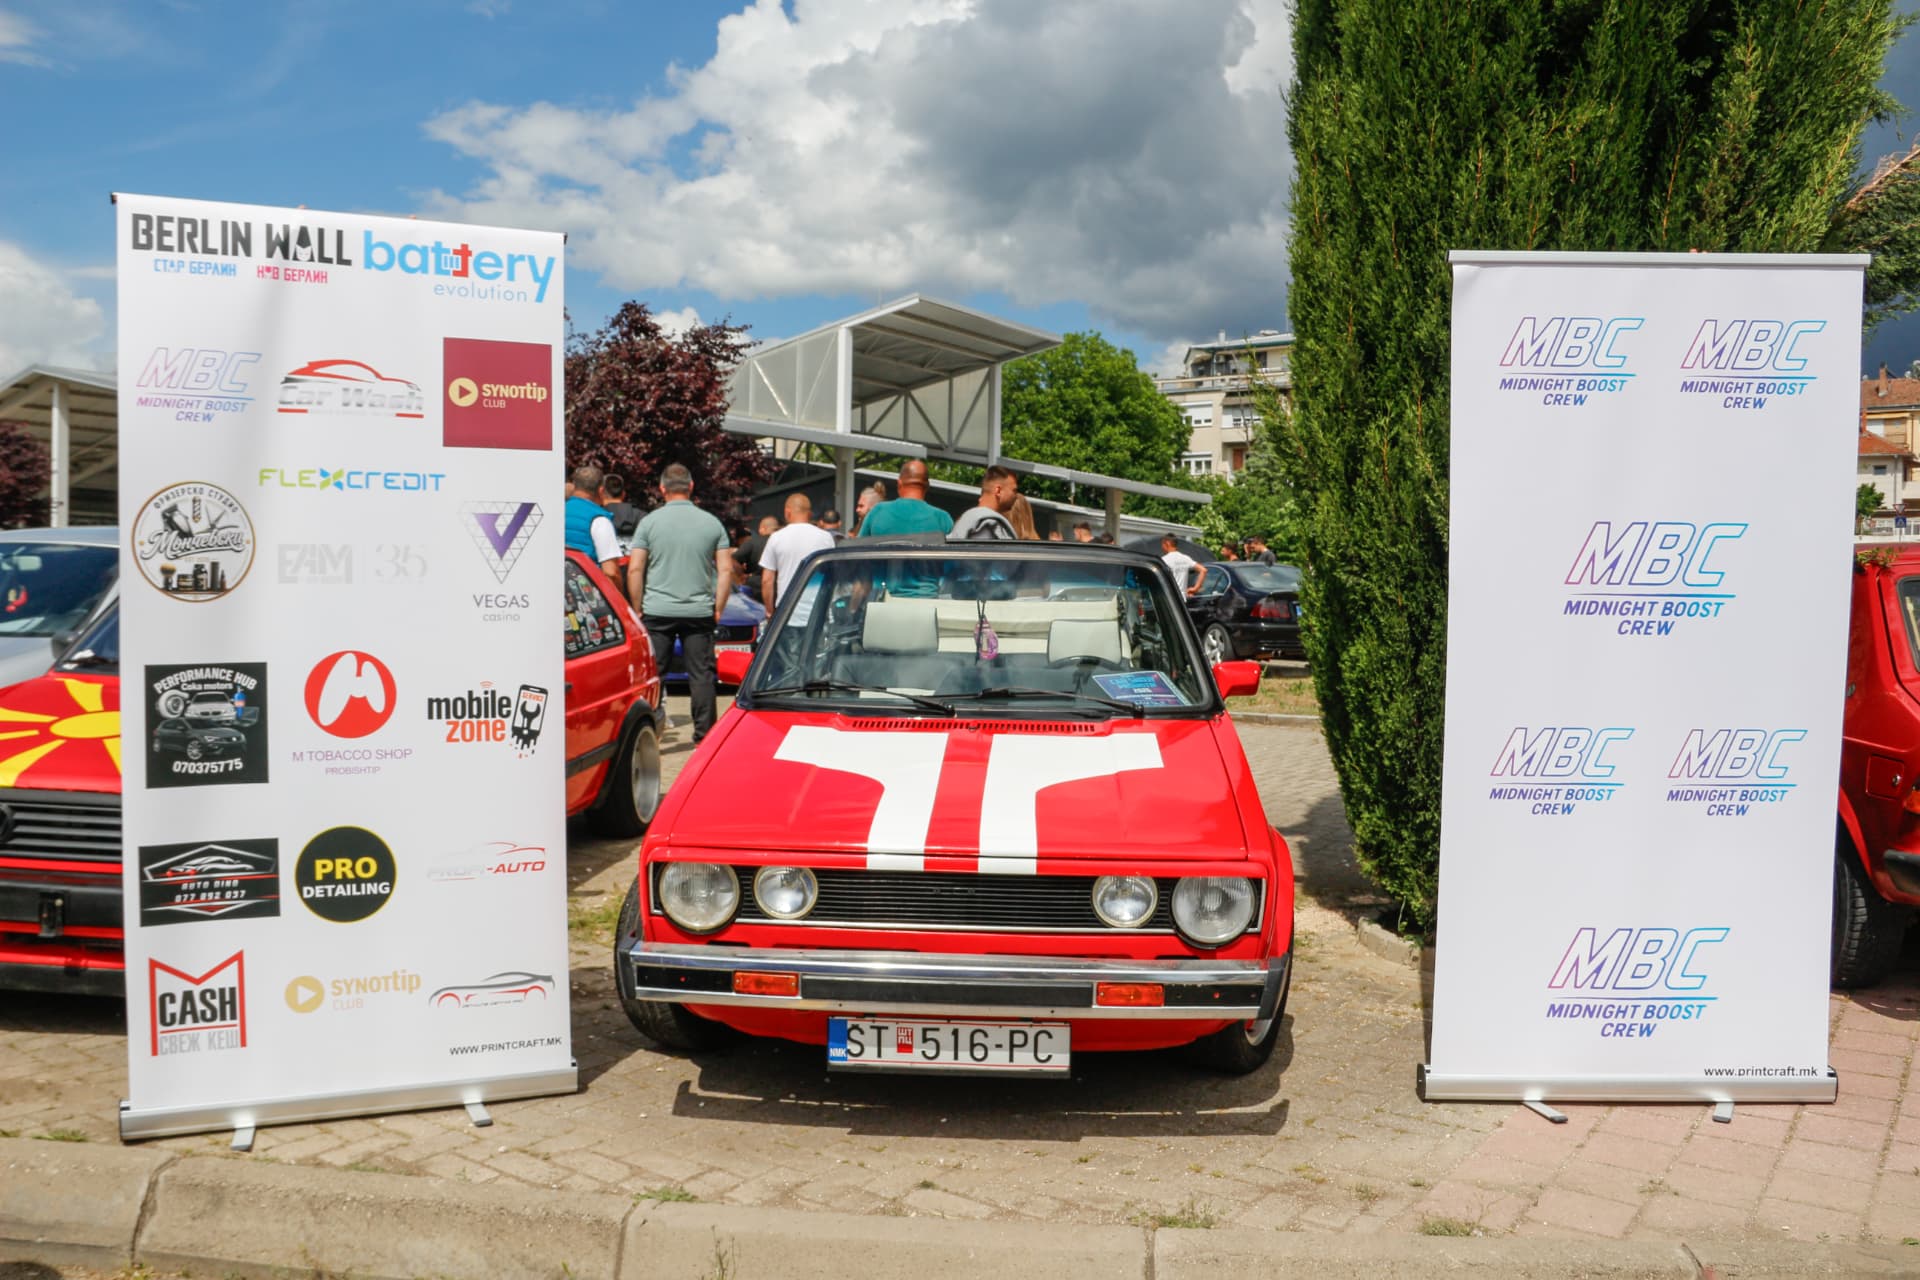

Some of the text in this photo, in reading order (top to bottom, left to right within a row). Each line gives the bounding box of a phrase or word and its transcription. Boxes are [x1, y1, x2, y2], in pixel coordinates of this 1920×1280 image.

[131, 213, 353, 266] BERLIN WALL
[363, 230, 555, 303] battery
[433, 281, 528, 303] evolution
[1499, 317, 1645, 368] MBC
[1680, 319, 1828, 371] MBC
[136, 347, 262, 393] MBC
[1499, 378, 1628, 392] MIDNIGHT BOOST
[1680, 381, 1809, 395] MIDNIGHT BOOST
[136, 396, 248, 412] MIDNIGHT BOOST
[482, 399, 506, 409] CLUB
[1543, 393, 1588, 406] CREW
[1723, 396, 1767, 409] CREW
[175, 410, 215, 423] CREW
[1564, 521, 1749, 587] MBC
[473, 594, 530, 609] VEGAS
[1563, 600, 1725, 618] MIDNIGHT BOOST
[482, 612, 521, 622] casino
[1617, 619, 1675, 636] CREW
[153, 667, 258, 695] PERFORMANCE HUB
[427, 690, 512, 720] mobile
[446, 718, 507, 743] zone
[292, 748, 413, 762] M TOBACCO SHOP
[1490, 727, 1636, 778] MBC
[1668, 729, 1808, 779] MBC
[172, 758, 244, 774] 070375775
[1489, 788, 1616, 801] MIDNIGHT BOOST
[1667, 789, 1789, 803] MIDNIGHT BOOST
[1531, 803, 1576, 816] CREW
[1706, 804, 1750, 817] CREW
[314, 857, 378, 881] PRO
[302, 881, 391, 900] DETAILING
[1547, 927, 1731, 990] MBC
[158, 986, 238, 1027] CASH
[332, 998, 364, 1011] CLUB
[1546, 1003, 1708, 1020] MIDNIGHT BOOST
[1600, 1022, 1658, 1038] CREW
[160, 1029, 239, 1055] СВЕЖ КЕШ
[449, 1037, 563, 1056] WWW.PRINTCRAFT.MK
[921, 1027, 1054, 1064] 516-PC
[829, 1047, 847, 1058] NMK
[1703, 1065, 1819, 1079] www.printcraft.mk
